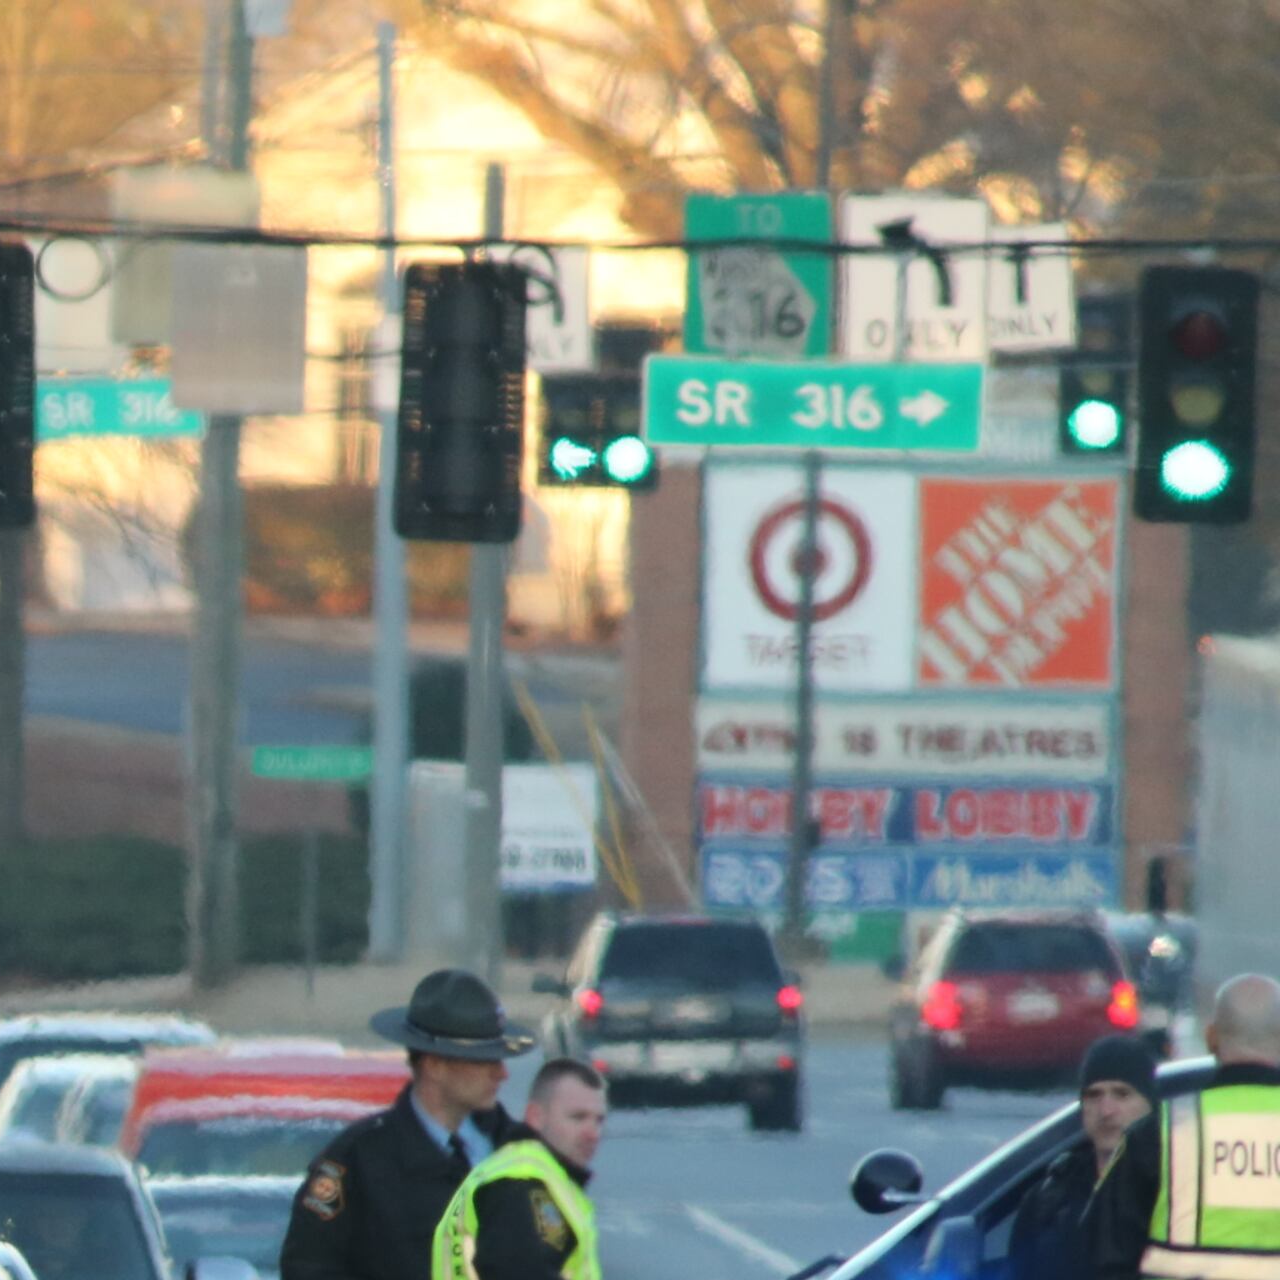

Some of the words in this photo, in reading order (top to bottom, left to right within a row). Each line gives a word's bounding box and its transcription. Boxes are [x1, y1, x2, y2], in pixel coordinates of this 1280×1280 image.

[737, 204, 782, 234] TO
[676, 379, 752, 426] SR
[791, 383, 885, 430] 316
[899, 722, 1099, 760] THEATRES
[916, 788, 1094, 839] LOBBY
